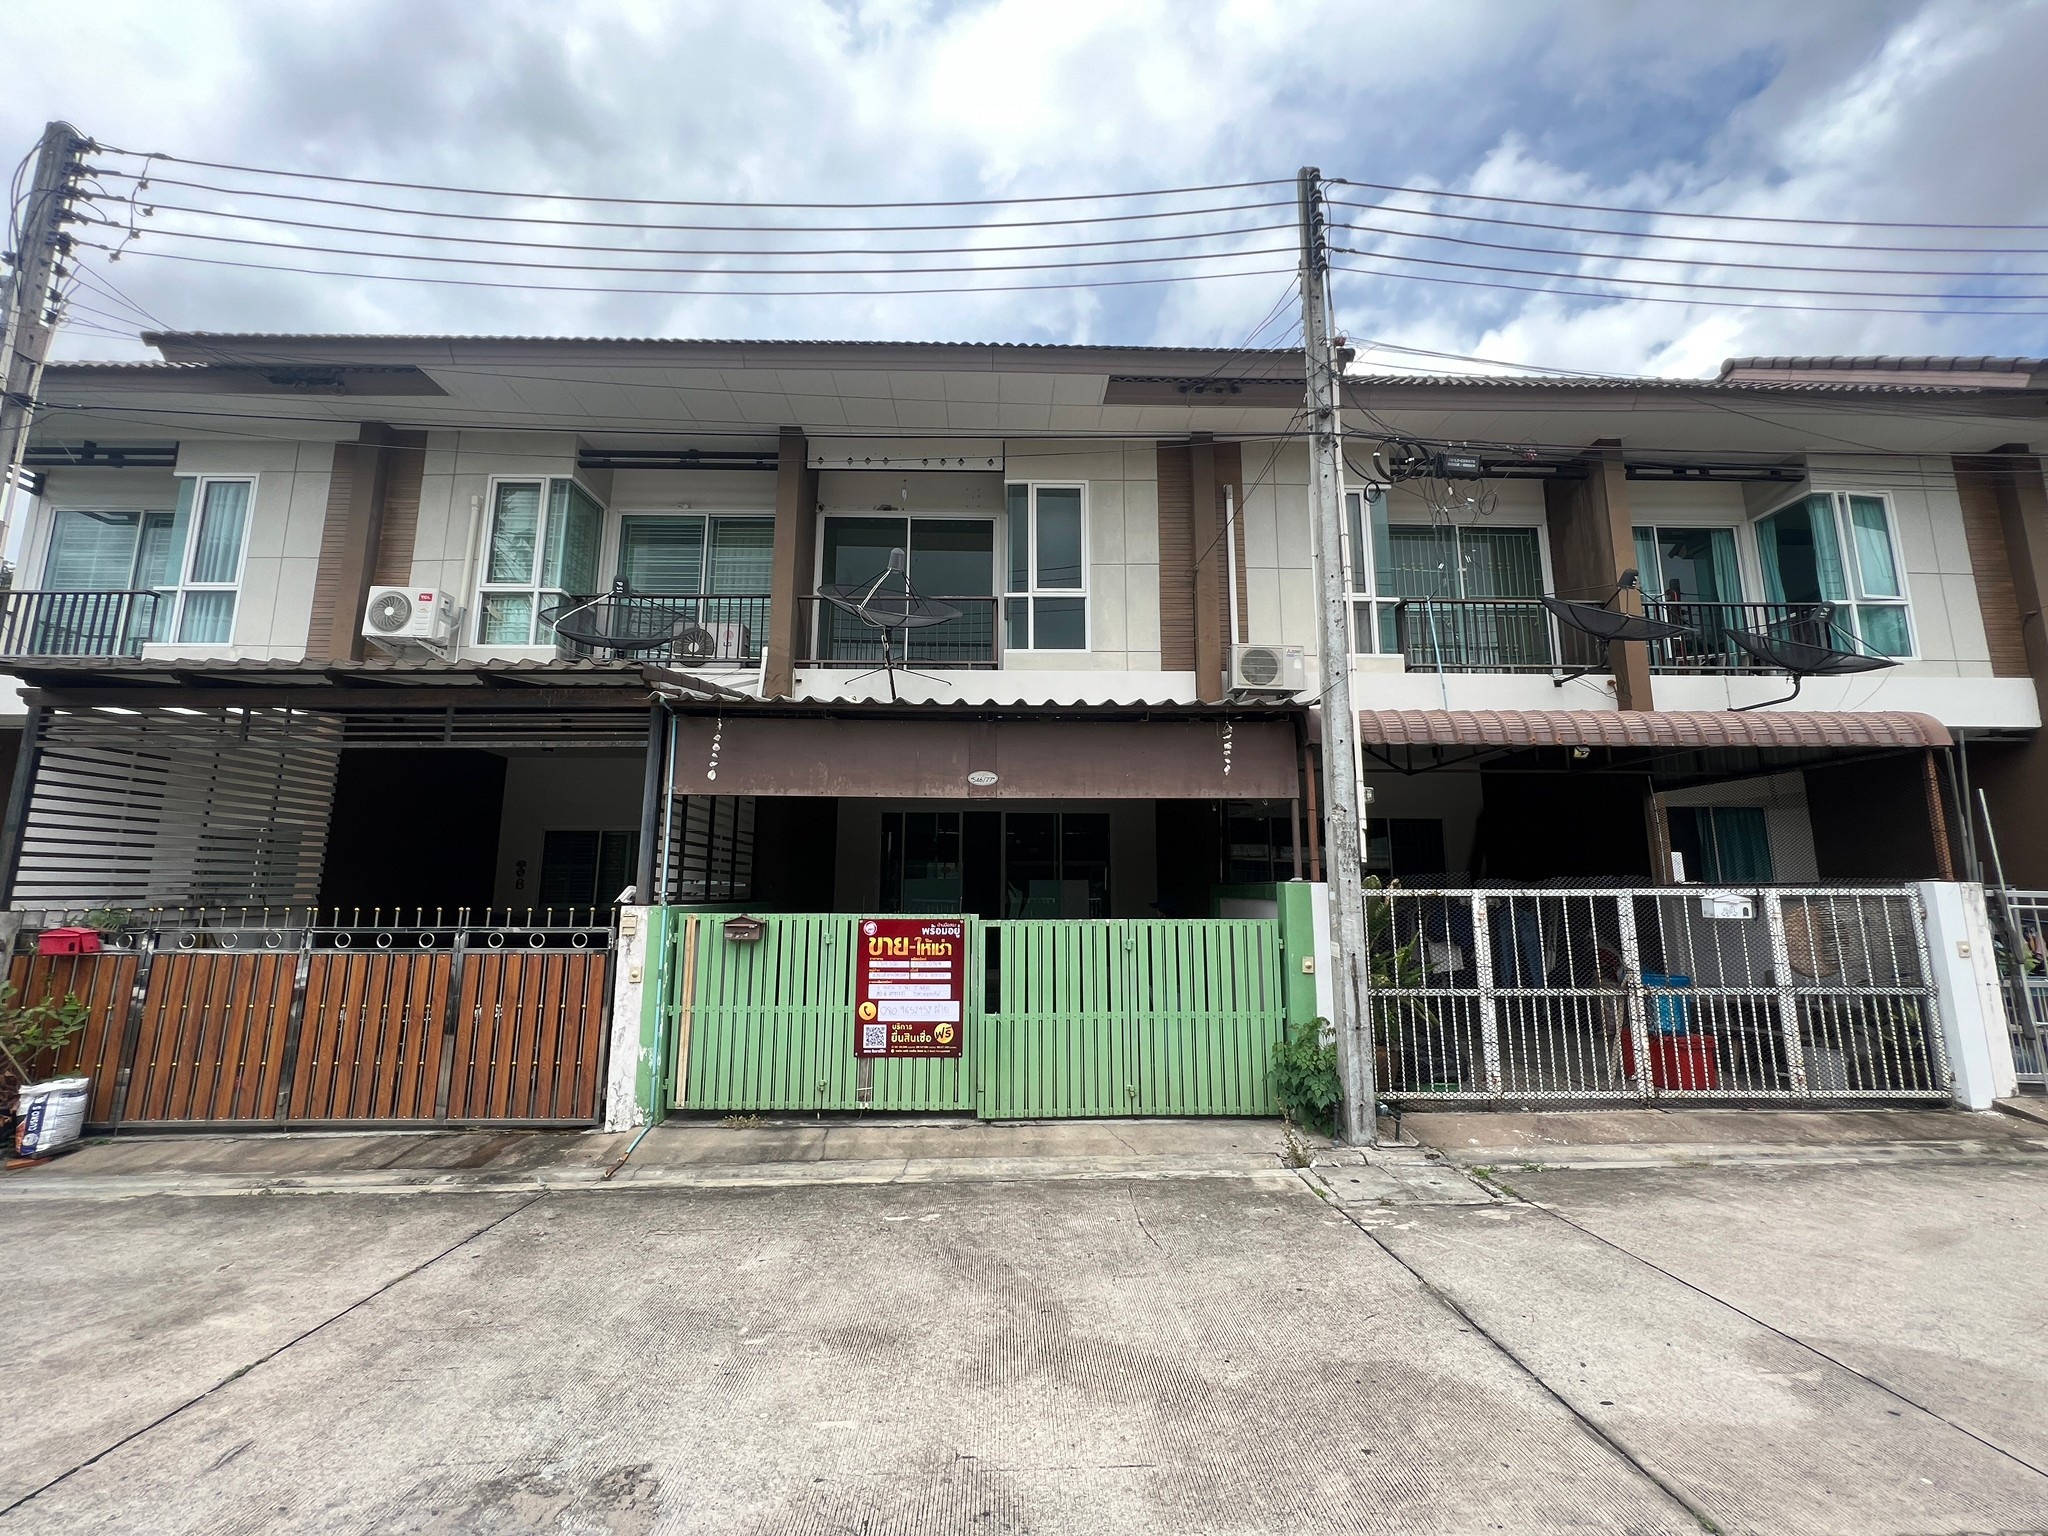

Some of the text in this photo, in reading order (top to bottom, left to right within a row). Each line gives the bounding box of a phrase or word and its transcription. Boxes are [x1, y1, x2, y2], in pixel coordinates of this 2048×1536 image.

[616, 581, 624, 593] PSI
[921, 923, 961, 939] พร้อมอยู่
[891, 1022, 913, 1031] บริการ
[891, 1030, 932, 1042] ยื่นสินเชื่อ
